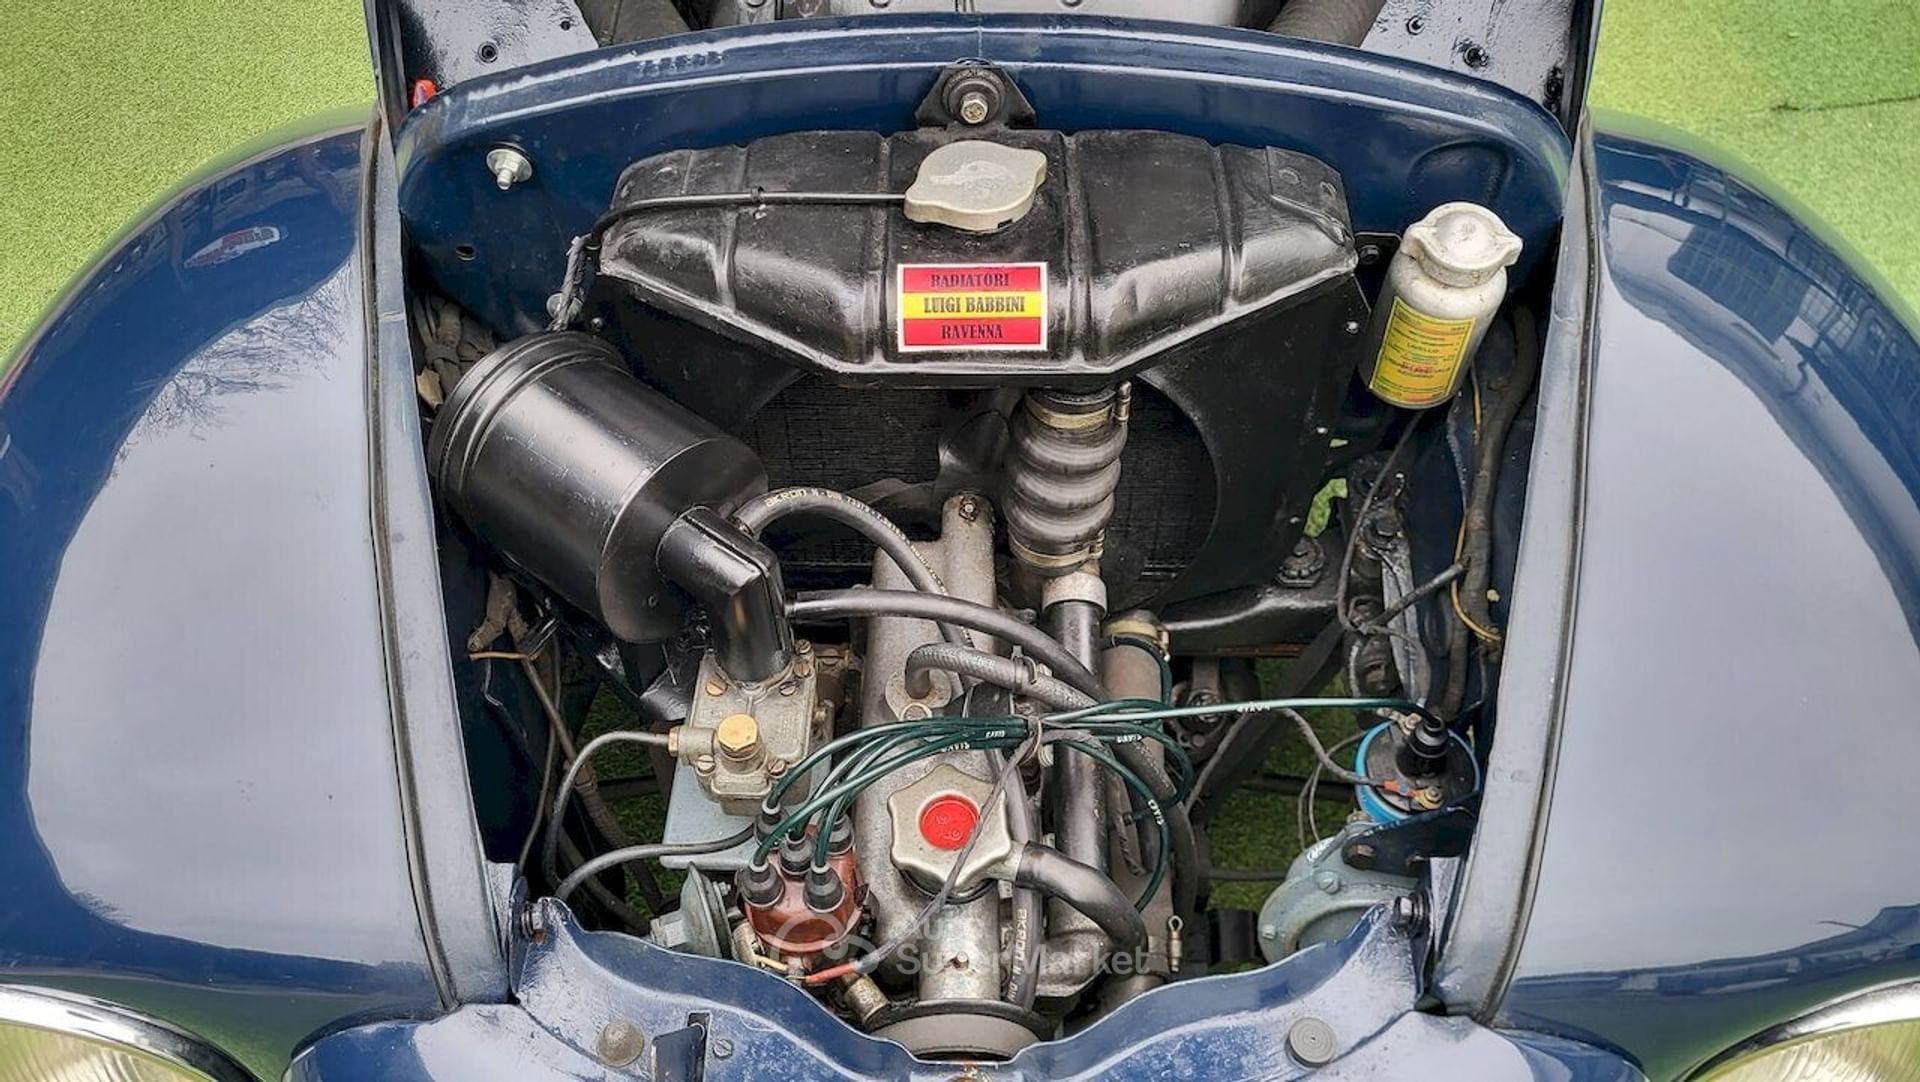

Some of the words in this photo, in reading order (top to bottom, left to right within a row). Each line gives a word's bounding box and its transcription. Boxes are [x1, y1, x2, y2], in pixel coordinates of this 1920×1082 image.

[930, 273, 1009, 288] RADIATORI
[923, 297, 961, 313] LUIGI
[965, 296, 1026, 313] BABBINI
[941, 324, 1004, 340] RAVENNA
